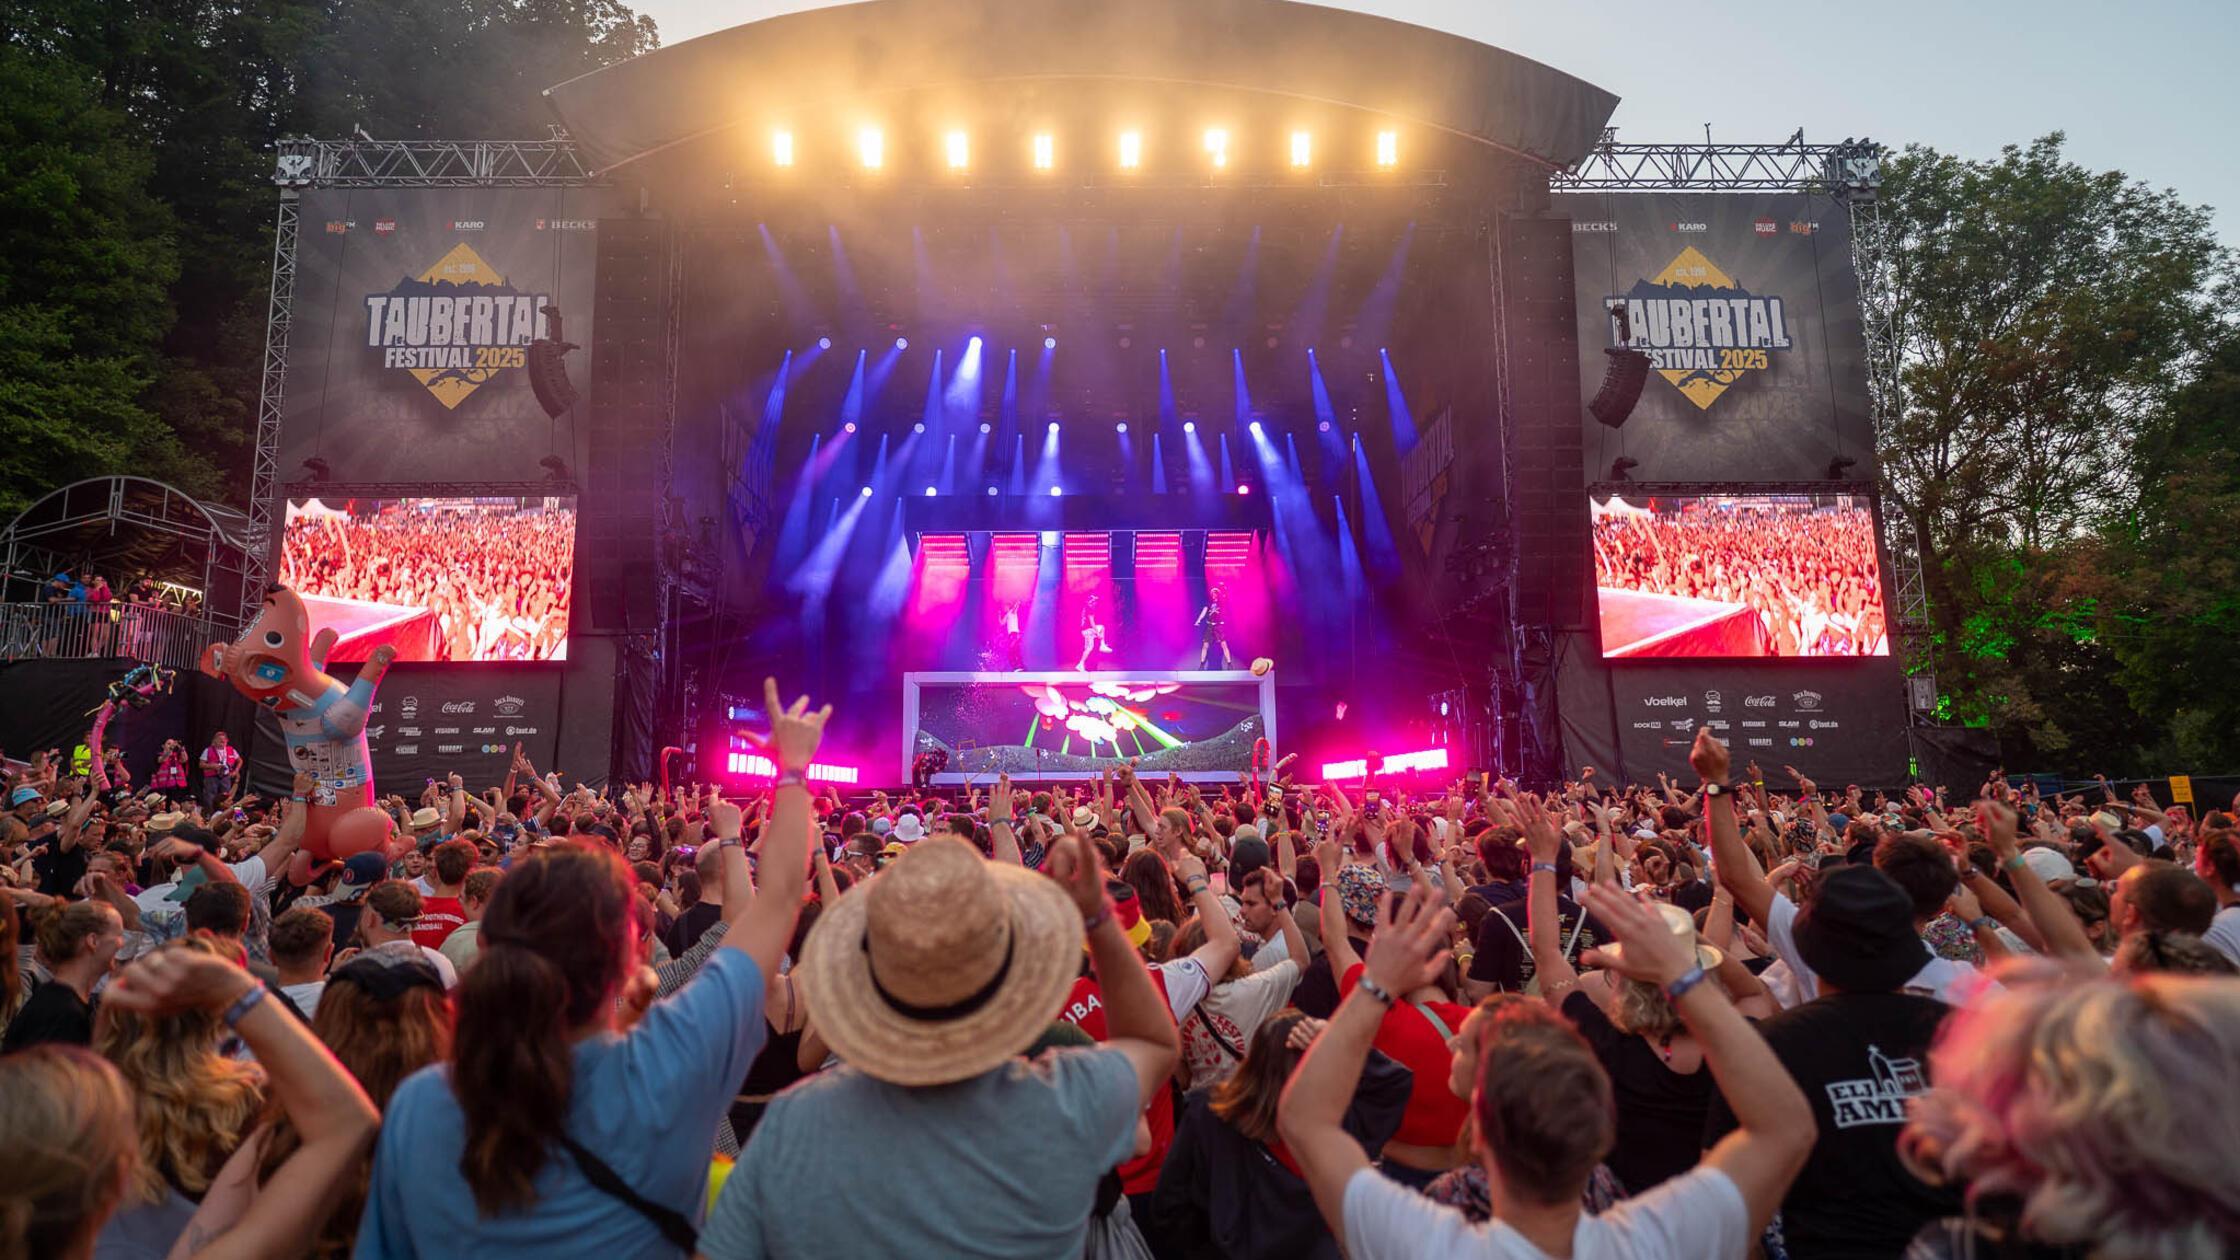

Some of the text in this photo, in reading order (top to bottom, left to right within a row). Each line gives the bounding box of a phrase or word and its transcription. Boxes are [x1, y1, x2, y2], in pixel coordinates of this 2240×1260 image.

[455, 221, 484, 229] KARO
[1678, 223, 1707, 231] KARO
[385, 347, 526, 369] FESTIVAL 2025
[1634, 349, 1768, 370] ESTIVAL 2025
[1644, 696, 1687, 707] Voelkel
